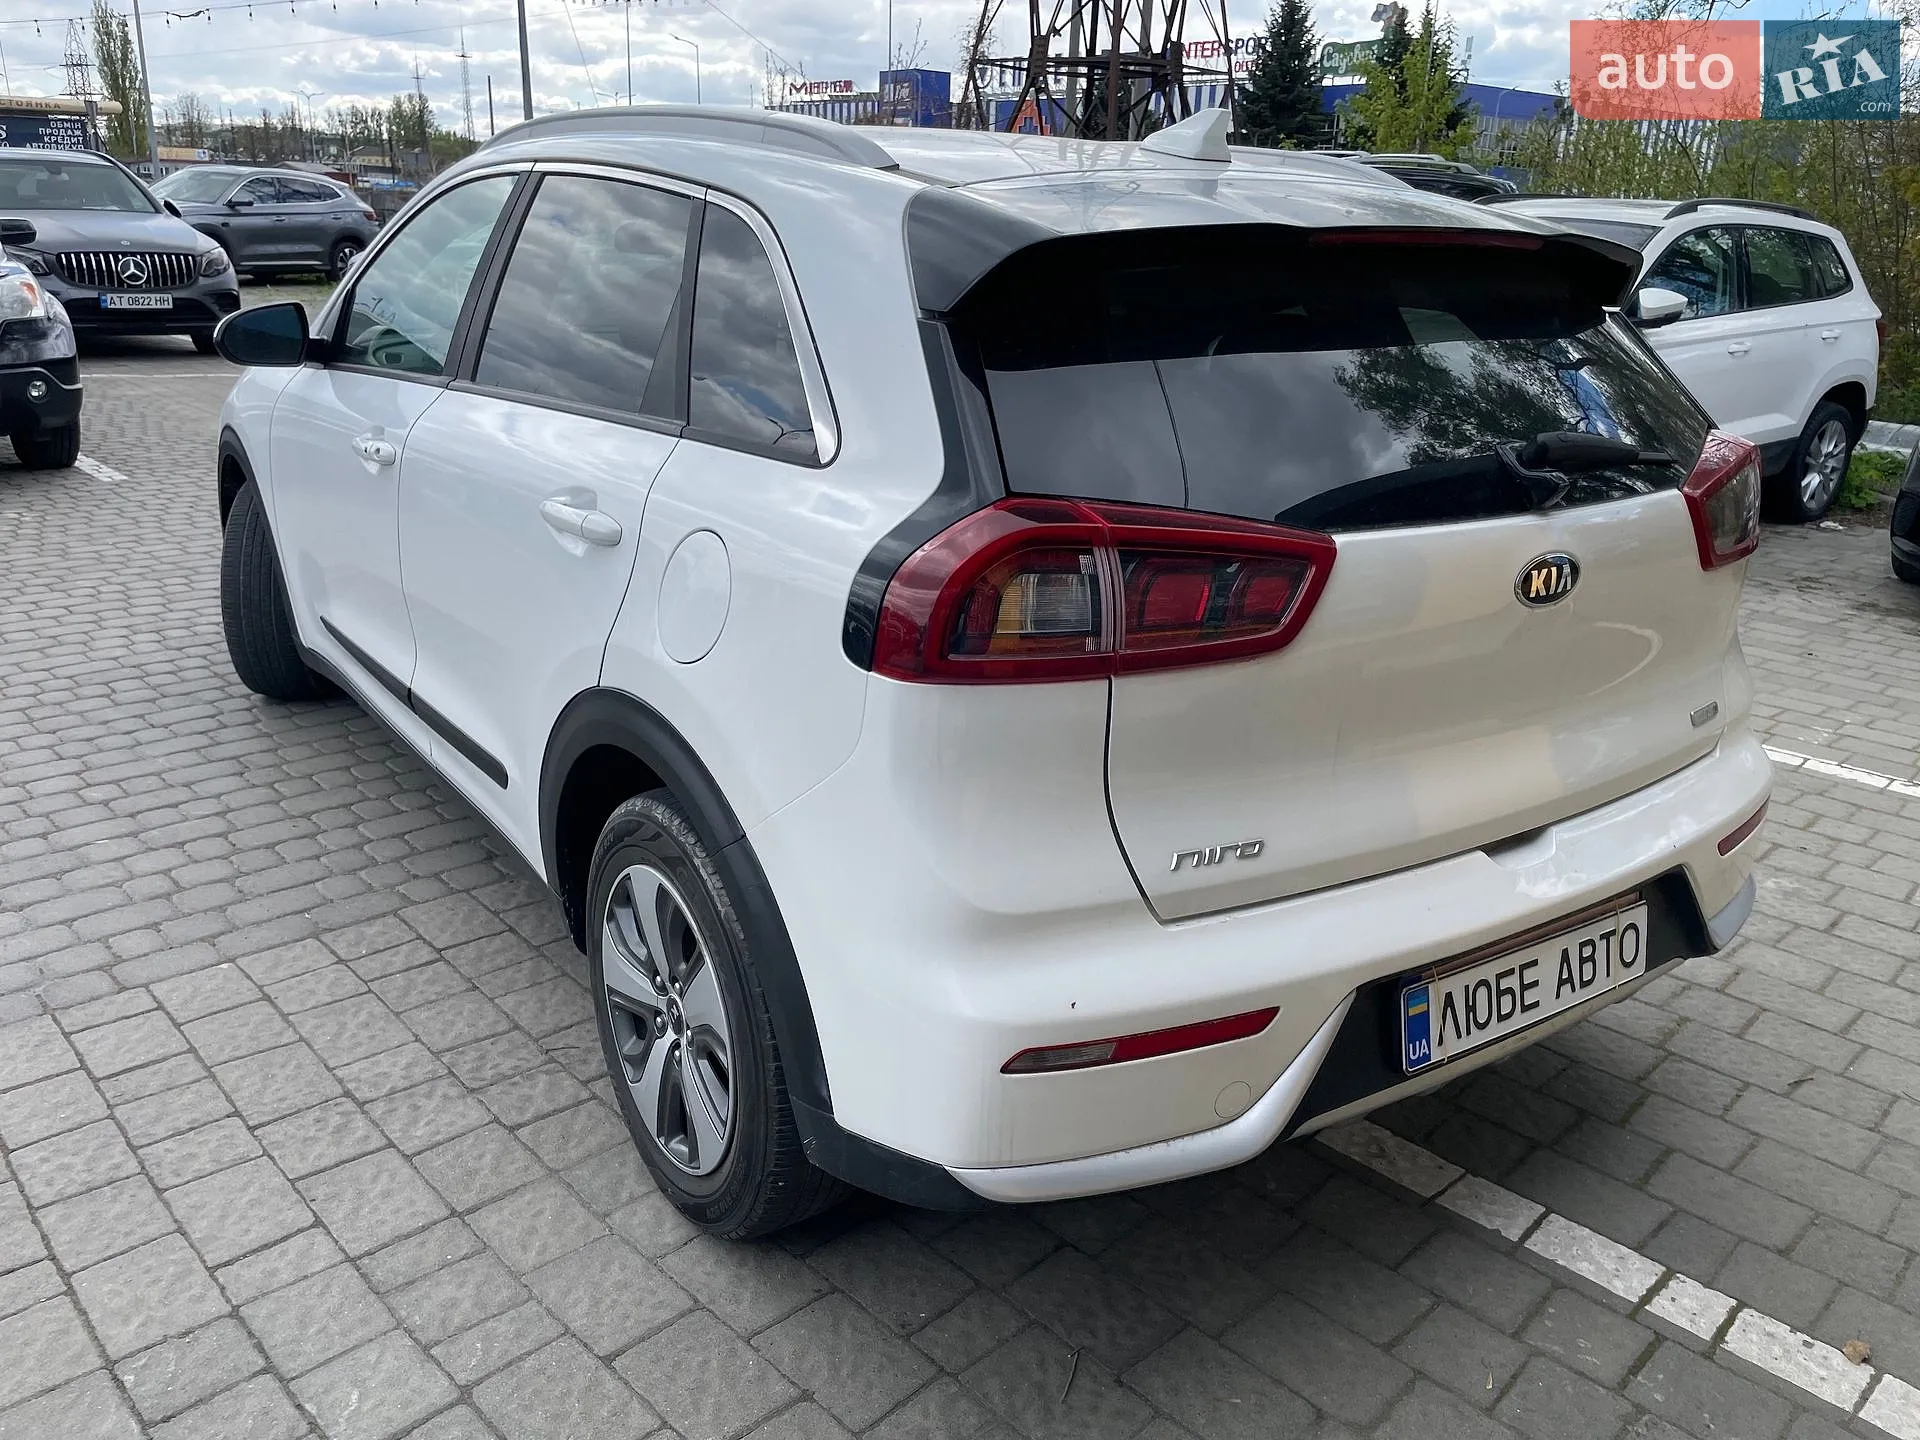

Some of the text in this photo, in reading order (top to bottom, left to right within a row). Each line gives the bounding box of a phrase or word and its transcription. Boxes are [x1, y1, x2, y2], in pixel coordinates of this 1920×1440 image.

[50, 121, 82, 129] ОБМІН
[39, 128, 83, 136] ПРОДАЖ
[44, 136, 84, 144] КРЕДИТ
[109, 296, 124, 306] AT
[127, 296, 153, 306] 0822
[154, 296, 170, 306] HH
[1529, 563, 1572, 598] KIA
[1437, 922, 1641, 1047] ЛЮБЕ АВТО
[1409, 1041, 1430, 1060] UA
